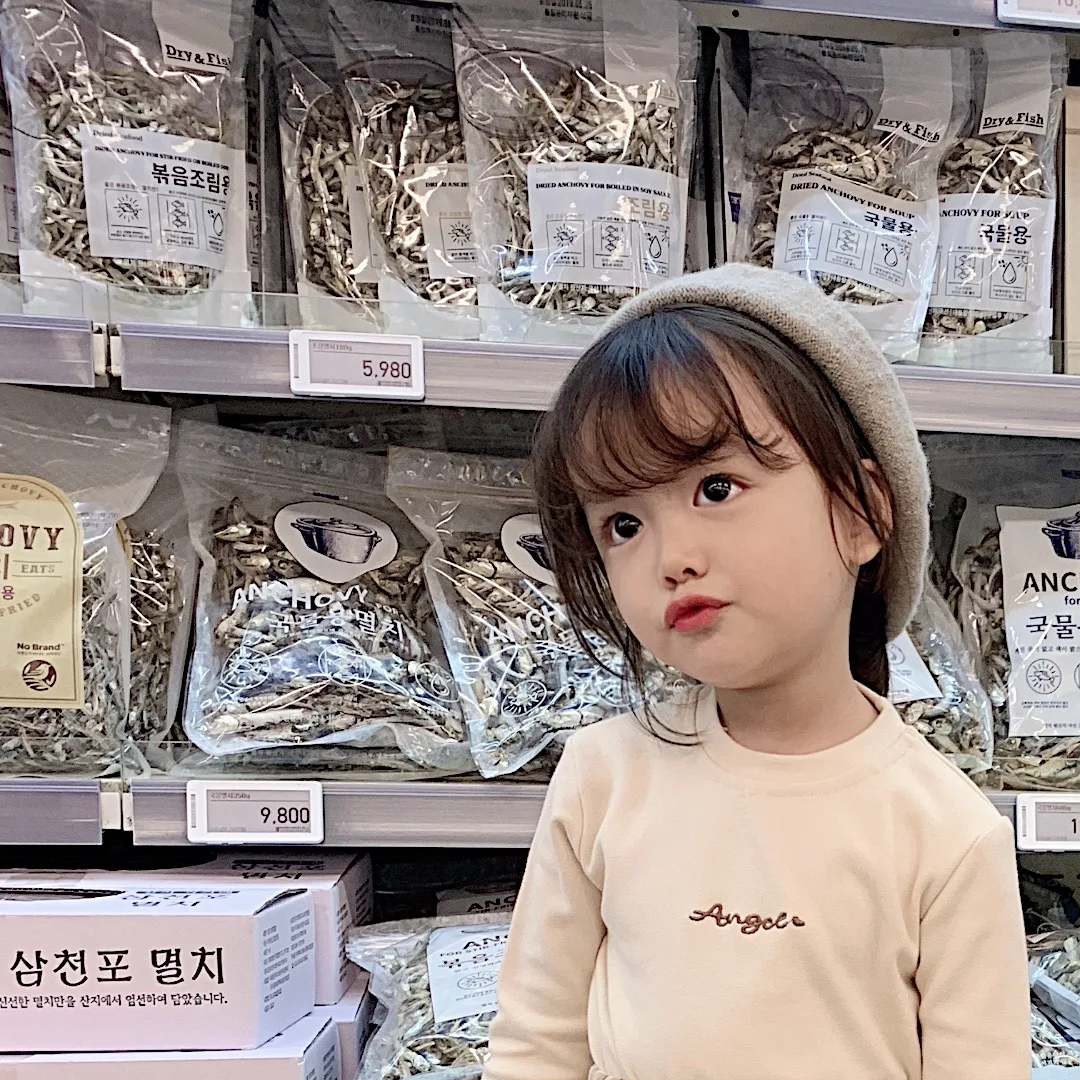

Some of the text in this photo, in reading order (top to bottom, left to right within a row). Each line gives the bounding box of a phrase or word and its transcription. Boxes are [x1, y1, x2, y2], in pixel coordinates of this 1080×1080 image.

[165, 45, 231, 67] Dry & Fis
[983, 112, 1044, 128] Dry & Fish
[877, 118, 940, 141] Dry & Fish
[790, 181, 916, 220] DRIED ANCHOVY FOR SOUP
[981, 209, 1001, 217] FOR
[362, 359, 411, 379] 5,980
[20, 564, 56, 573] EATS
[231, 579, 368, 611] ANCHOVY
[1065, 595, 1080, 606] for
[17, 642, 61, 651] No Brand
[260, 806, 310, 824] 9,800
[10, 946, 225, 988] 삼천포 멸치
[33, 995, 77, 1008] 멸치만을
[79, 994, 122, 1007] 산지에서
[170, 992, 228, 1006] 담았습니다.
